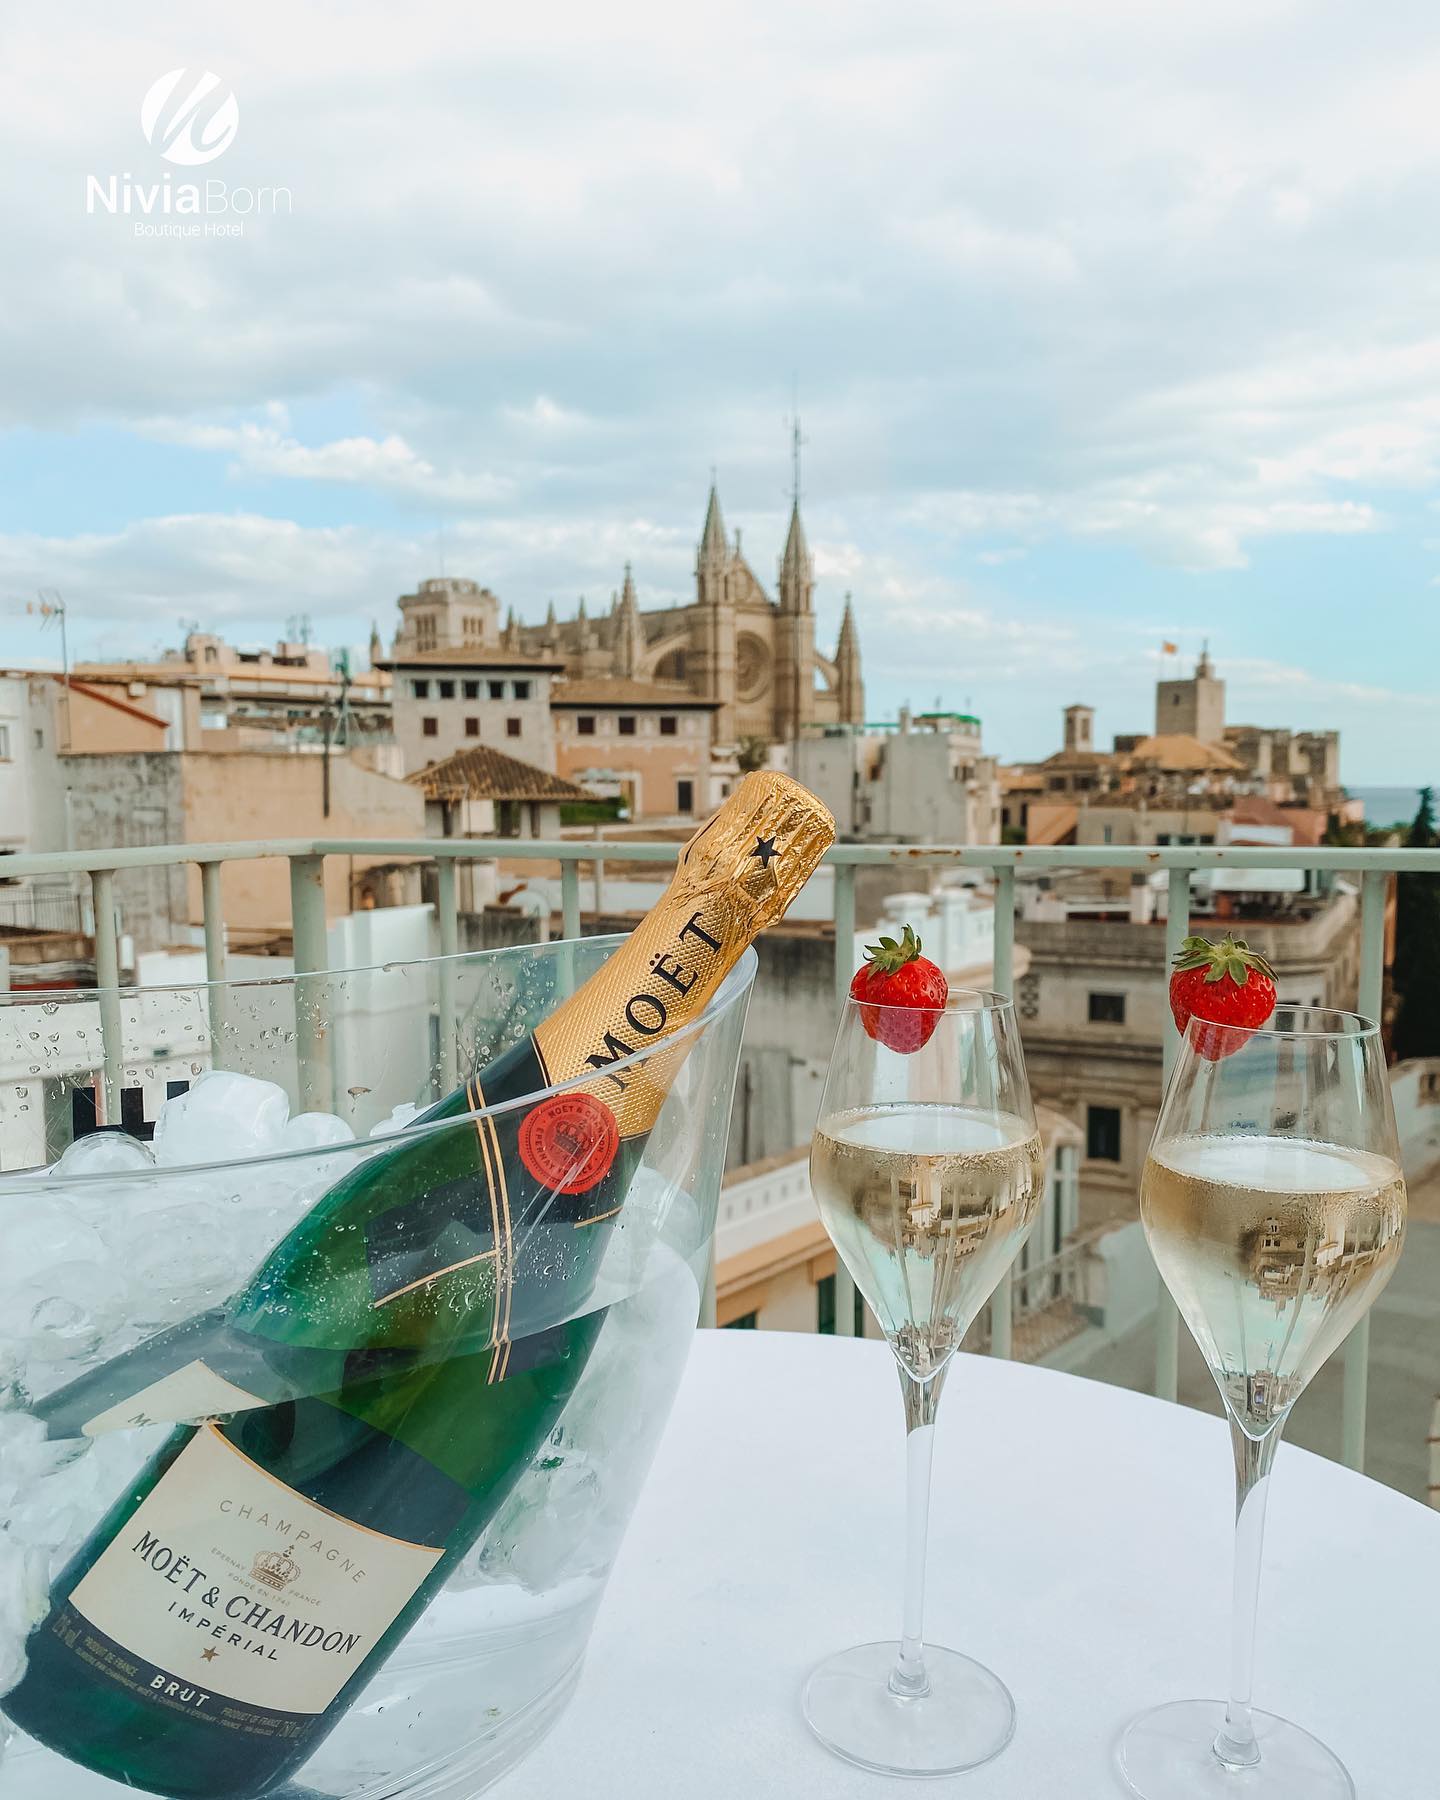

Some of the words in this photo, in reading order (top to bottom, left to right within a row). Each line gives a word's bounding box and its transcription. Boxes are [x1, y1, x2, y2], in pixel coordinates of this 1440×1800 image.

[584, 911, 723, 1093] MOËT
[219, 1500, 366, 1583] CHAMPAGNE
[132, 1530, 207, 1594] MOËT
[201, 1586, 221, 1608] &
[225, 1595, 362, 1655] CHANDON
[168, 1601, 278, 1661] IMPÉRIAL
[150, 1674, 210, 1707] BRUT
